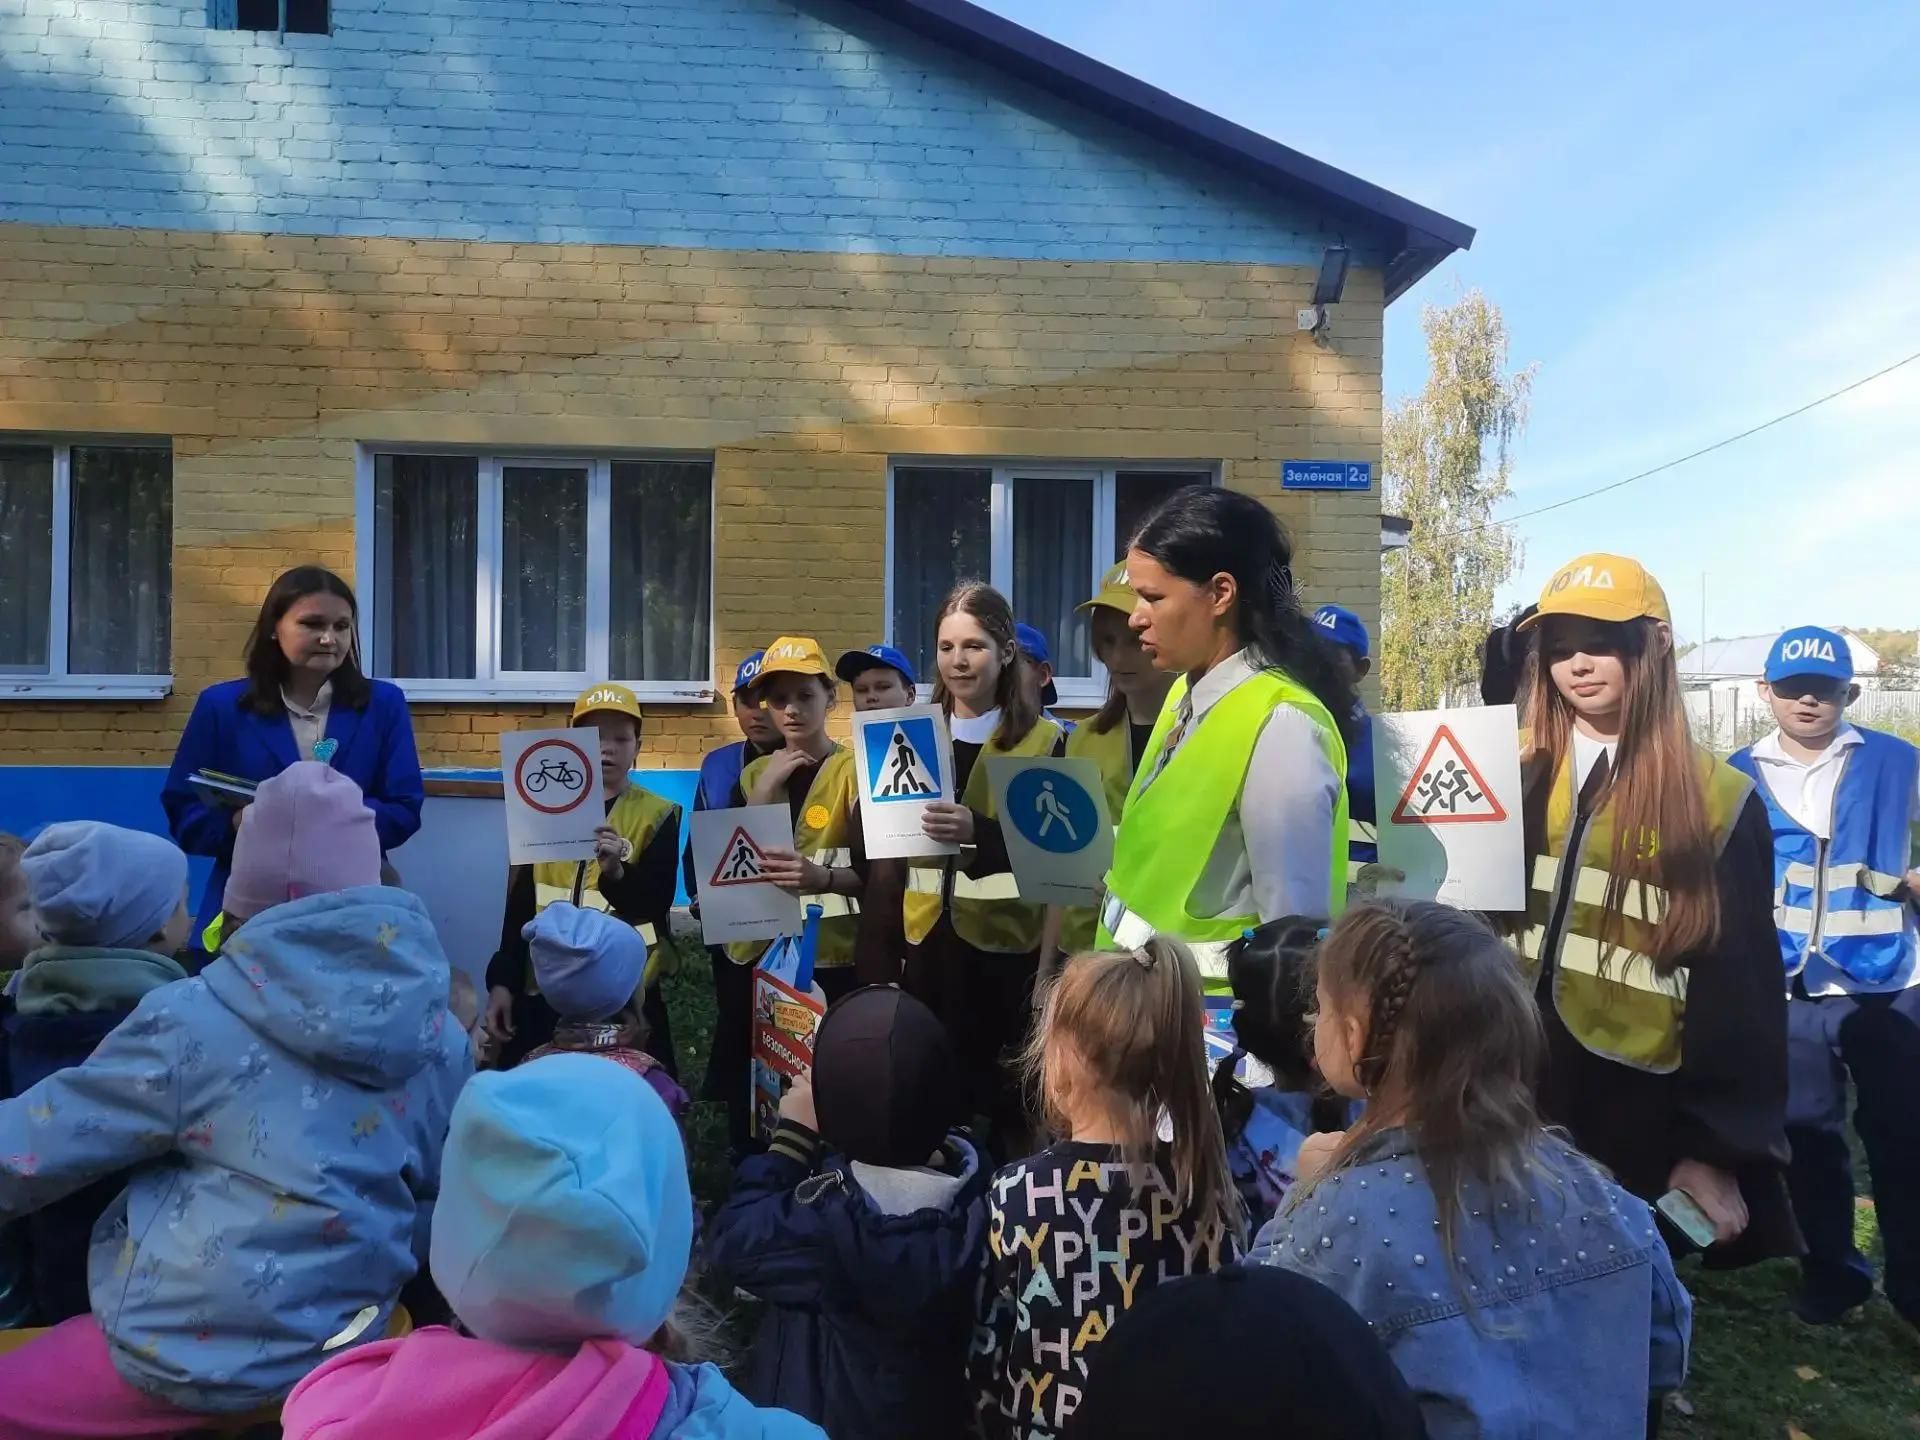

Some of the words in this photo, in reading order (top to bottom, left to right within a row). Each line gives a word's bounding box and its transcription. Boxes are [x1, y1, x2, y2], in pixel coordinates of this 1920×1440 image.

[1548, 565, 1616, 597] ЮИД
[1311, 610, 1337, 630] ИД
[1781, 637, 1836, 663] ЮИД
[741, 659, 763, 681] ЮИ
